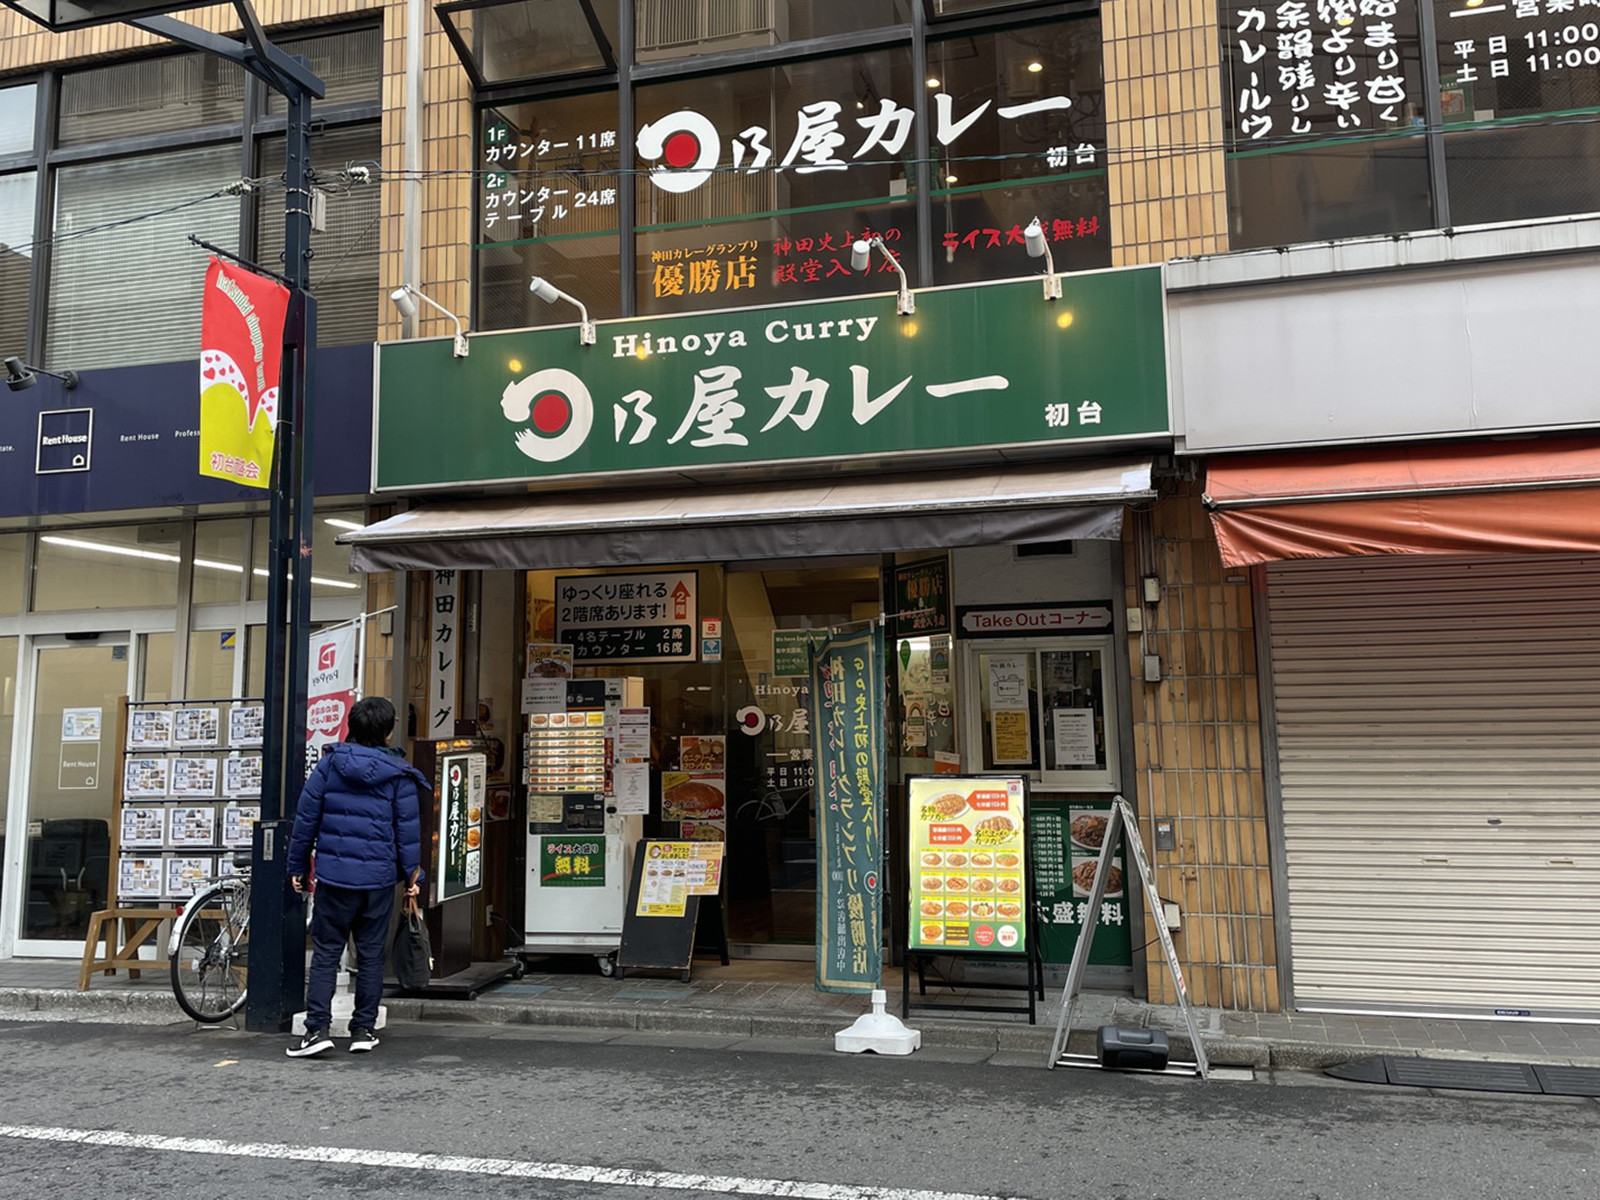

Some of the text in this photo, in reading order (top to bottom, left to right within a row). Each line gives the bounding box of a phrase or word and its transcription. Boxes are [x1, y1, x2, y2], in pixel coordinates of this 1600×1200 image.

[1523, 23, 1600, 49] 11:00
[487, 127, 506, 142] 1F
[485, 130, 617, 163] カウンター 11席
[1046, 142, 1097, 168] 初台
[486, 173, 506, 188] 2F
[485, 186, 617, 209] カウンター 24席
[484, 204, 568, 229] テーブル
[942, 216, 1099, 253] ライス大無料
[651, 239, 759, 263] 神田カレーグランプリ
[652, 254, 758, 298] 優勝店
[612, 315, 879, 358] Hinoya Curry
[1044, 400, 1103, 428] 初台
[42, 433, 88, 446] Rent House
[120, 432, 160, 442] Rent House
[562, 581, 668, 601] ゆっくり座れる
[577, 644, 646, 656] カウンター
[754, 684, 809, 697] Hinoya
[555, 855, 590, 875] 無料
